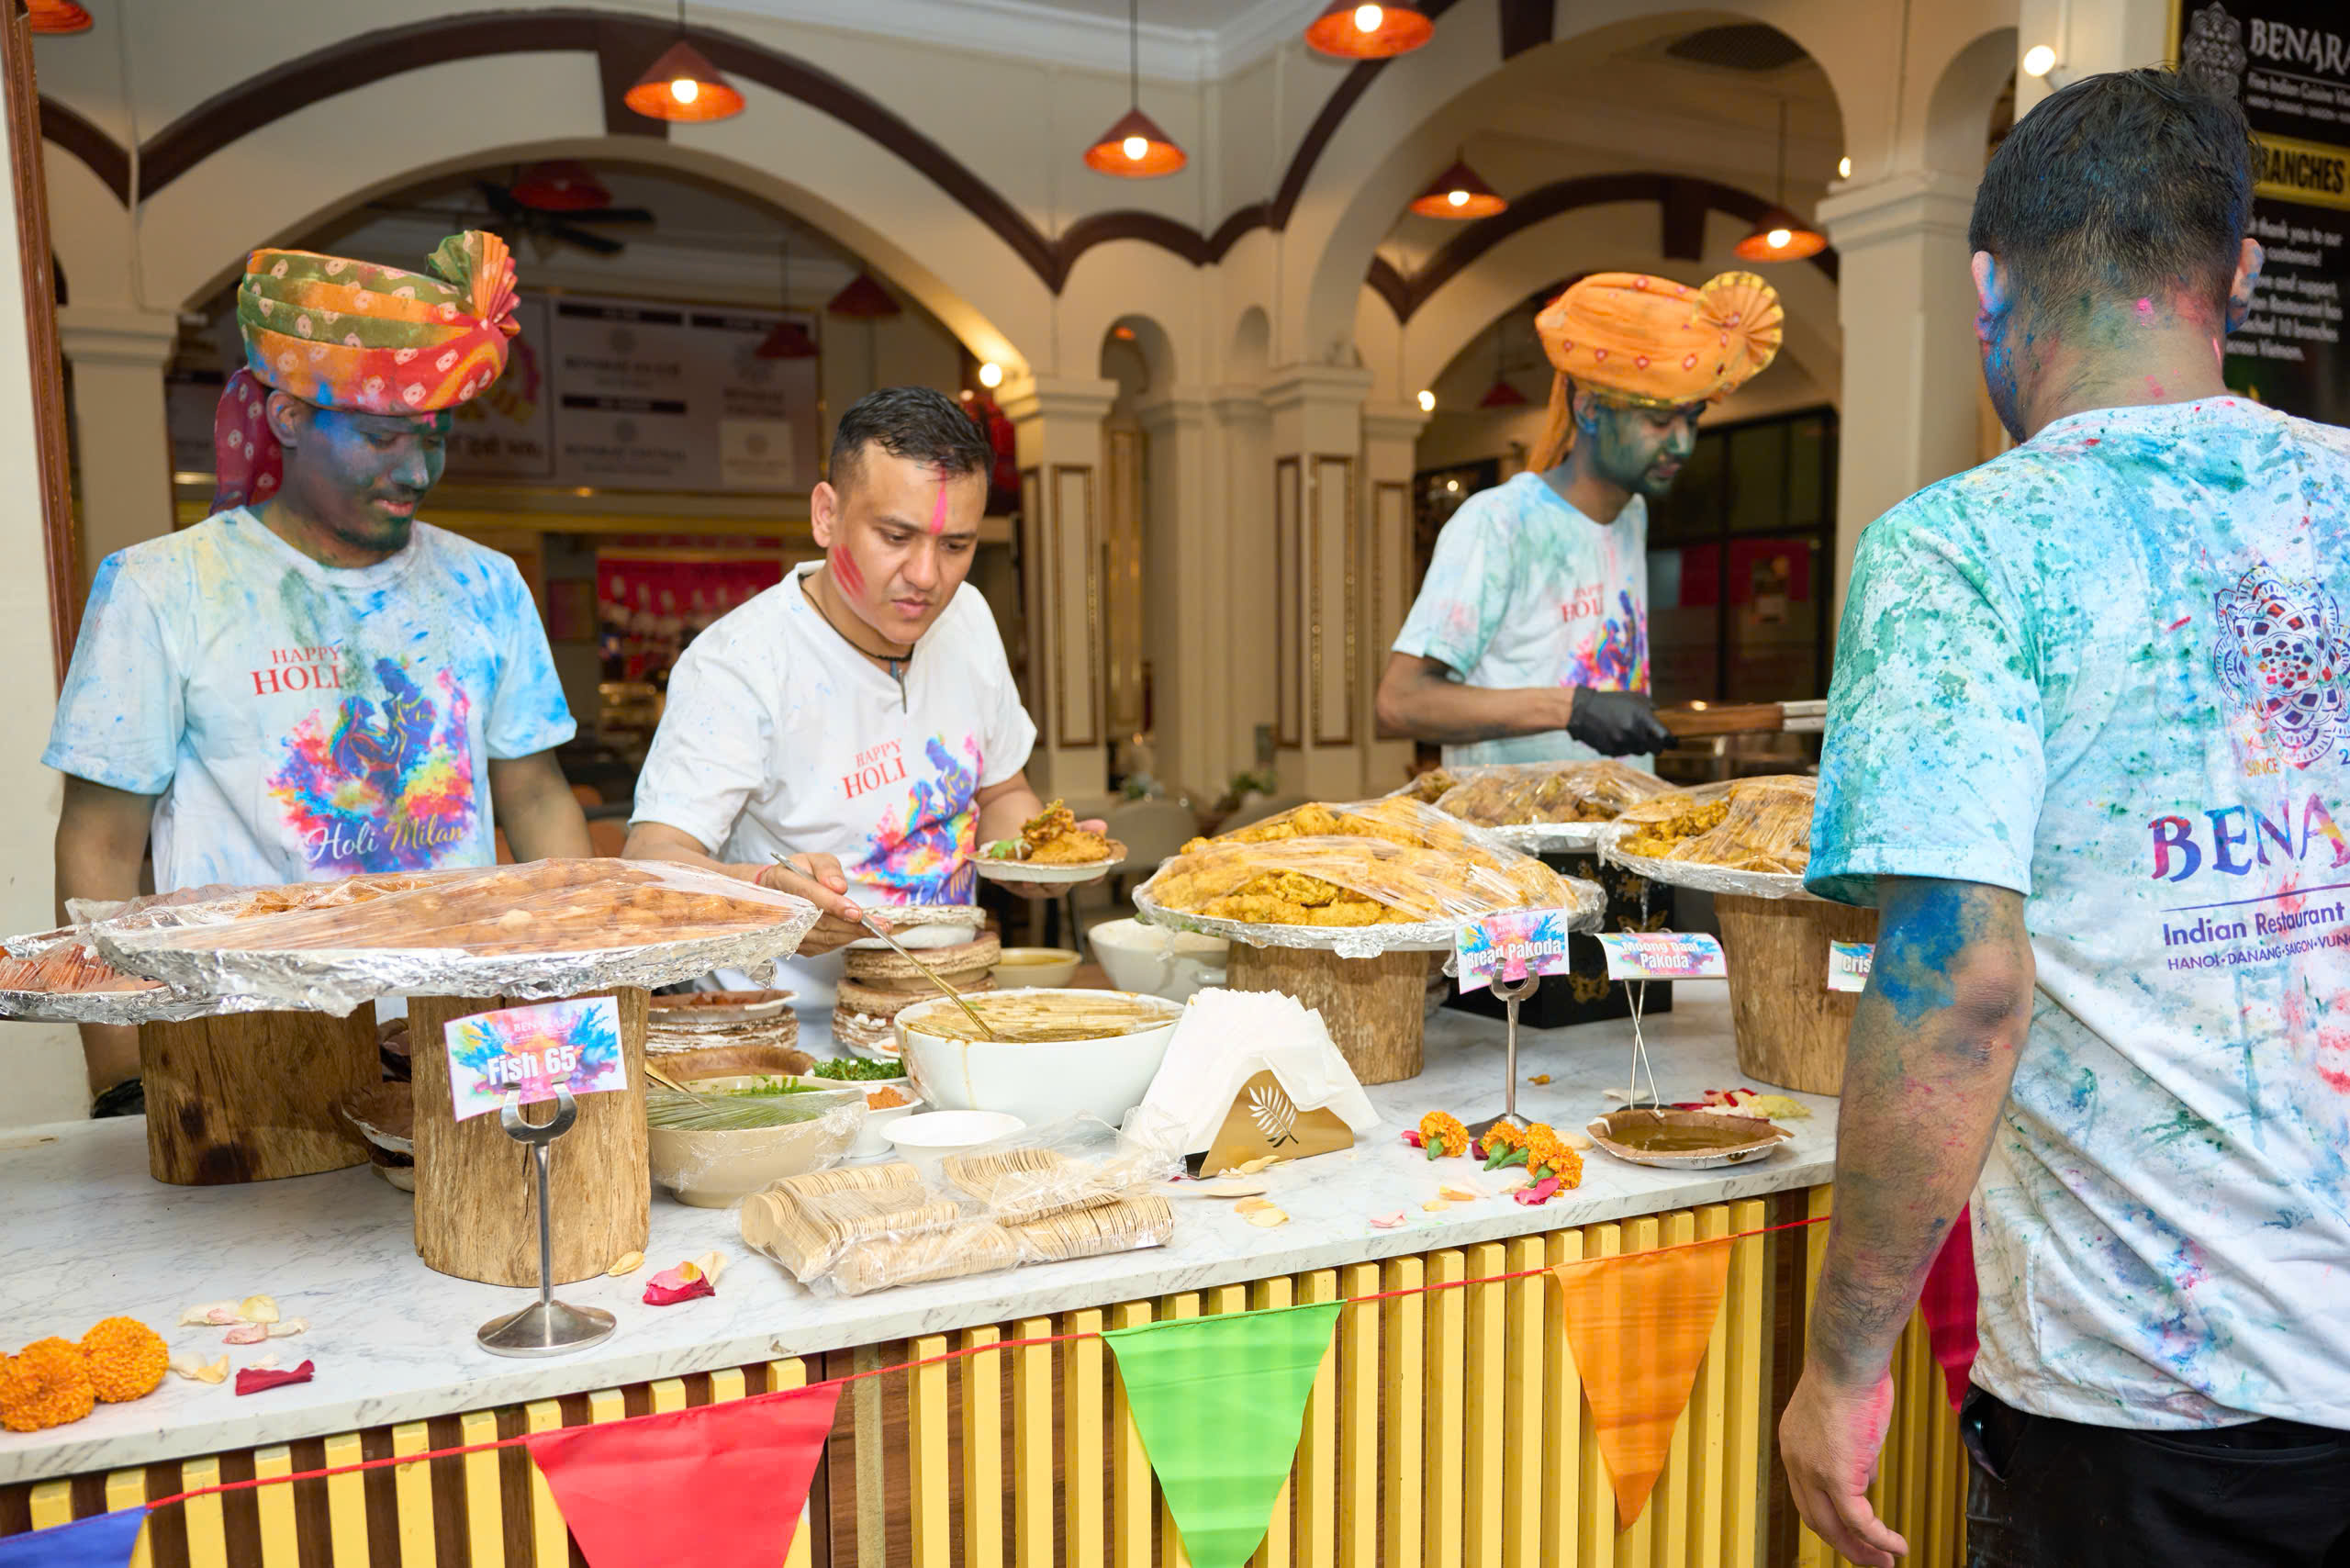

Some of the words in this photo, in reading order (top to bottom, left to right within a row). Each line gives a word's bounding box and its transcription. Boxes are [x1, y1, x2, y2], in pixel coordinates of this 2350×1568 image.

[271, 646, 341, 664] HAPPY
[250, 664, 342, 696] HOLI
[854, 737, 902, 769] HAPPY
[842, 756, 909, 800] HOLI
[304, 820, 380, 863] Holi
[384, 812, 464, 852] Milan
[2147, 792, 2350, 883] BENA
[2163, 917, 2248, 946] Indian
[2255, 902, 2345, 936] Restaurant
[1466, 945, 1504, 968] Bread
[1508, 937, 1562, 960] Pakoda
[1639, 953, 1689, 969] Pakoda
[487, 1051, 539, 1086] Fish
[544, 1045, 577, 1074] 65
